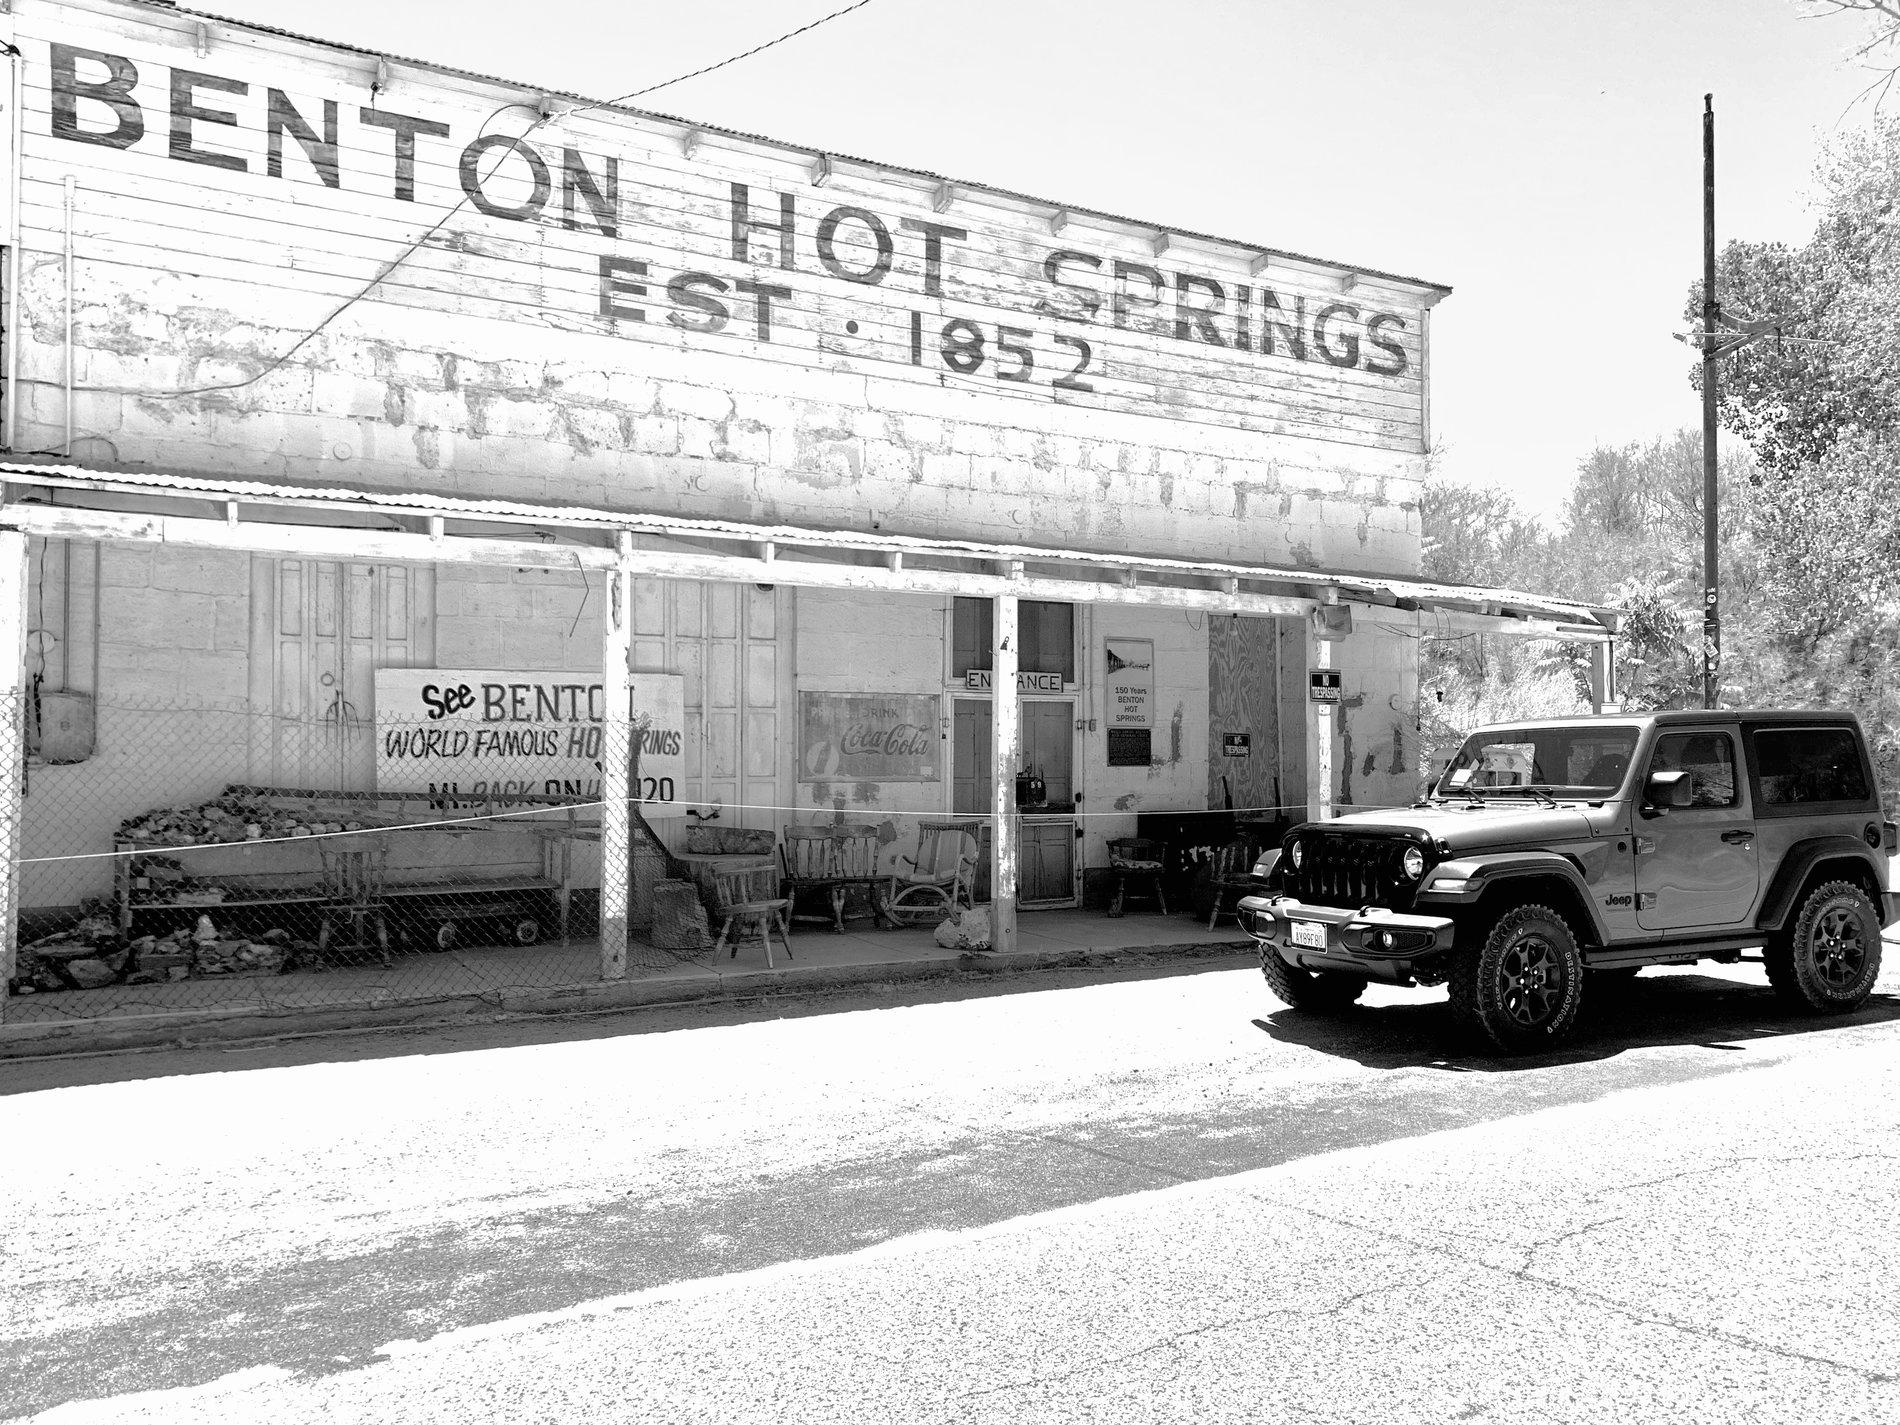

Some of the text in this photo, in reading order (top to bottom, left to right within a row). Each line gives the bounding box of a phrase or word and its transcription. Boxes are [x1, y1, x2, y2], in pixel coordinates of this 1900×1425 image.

[50, 42, 1408, 377] BENTON HOT SPRINGS
[599, 256, 1094, 392] EST 1852
[968, 672, 1060, 691] ENANCE
[1115, 686, 1128, 694] 150
[1311, 686, 1340, 699] TRESPASSING
[421, 682, 636, 723] See BENTO
[1124, 705, 1138, 713] HOT
[1115, 714, 1146, 723] SPRINGS
[386, 728, 470, 759] WORLD
[473, 728, 559, 758] FAMOUS
[1605, 893, 1632, 907] Jeep
[1551, 951, 1576, 1030] DESTINATION
